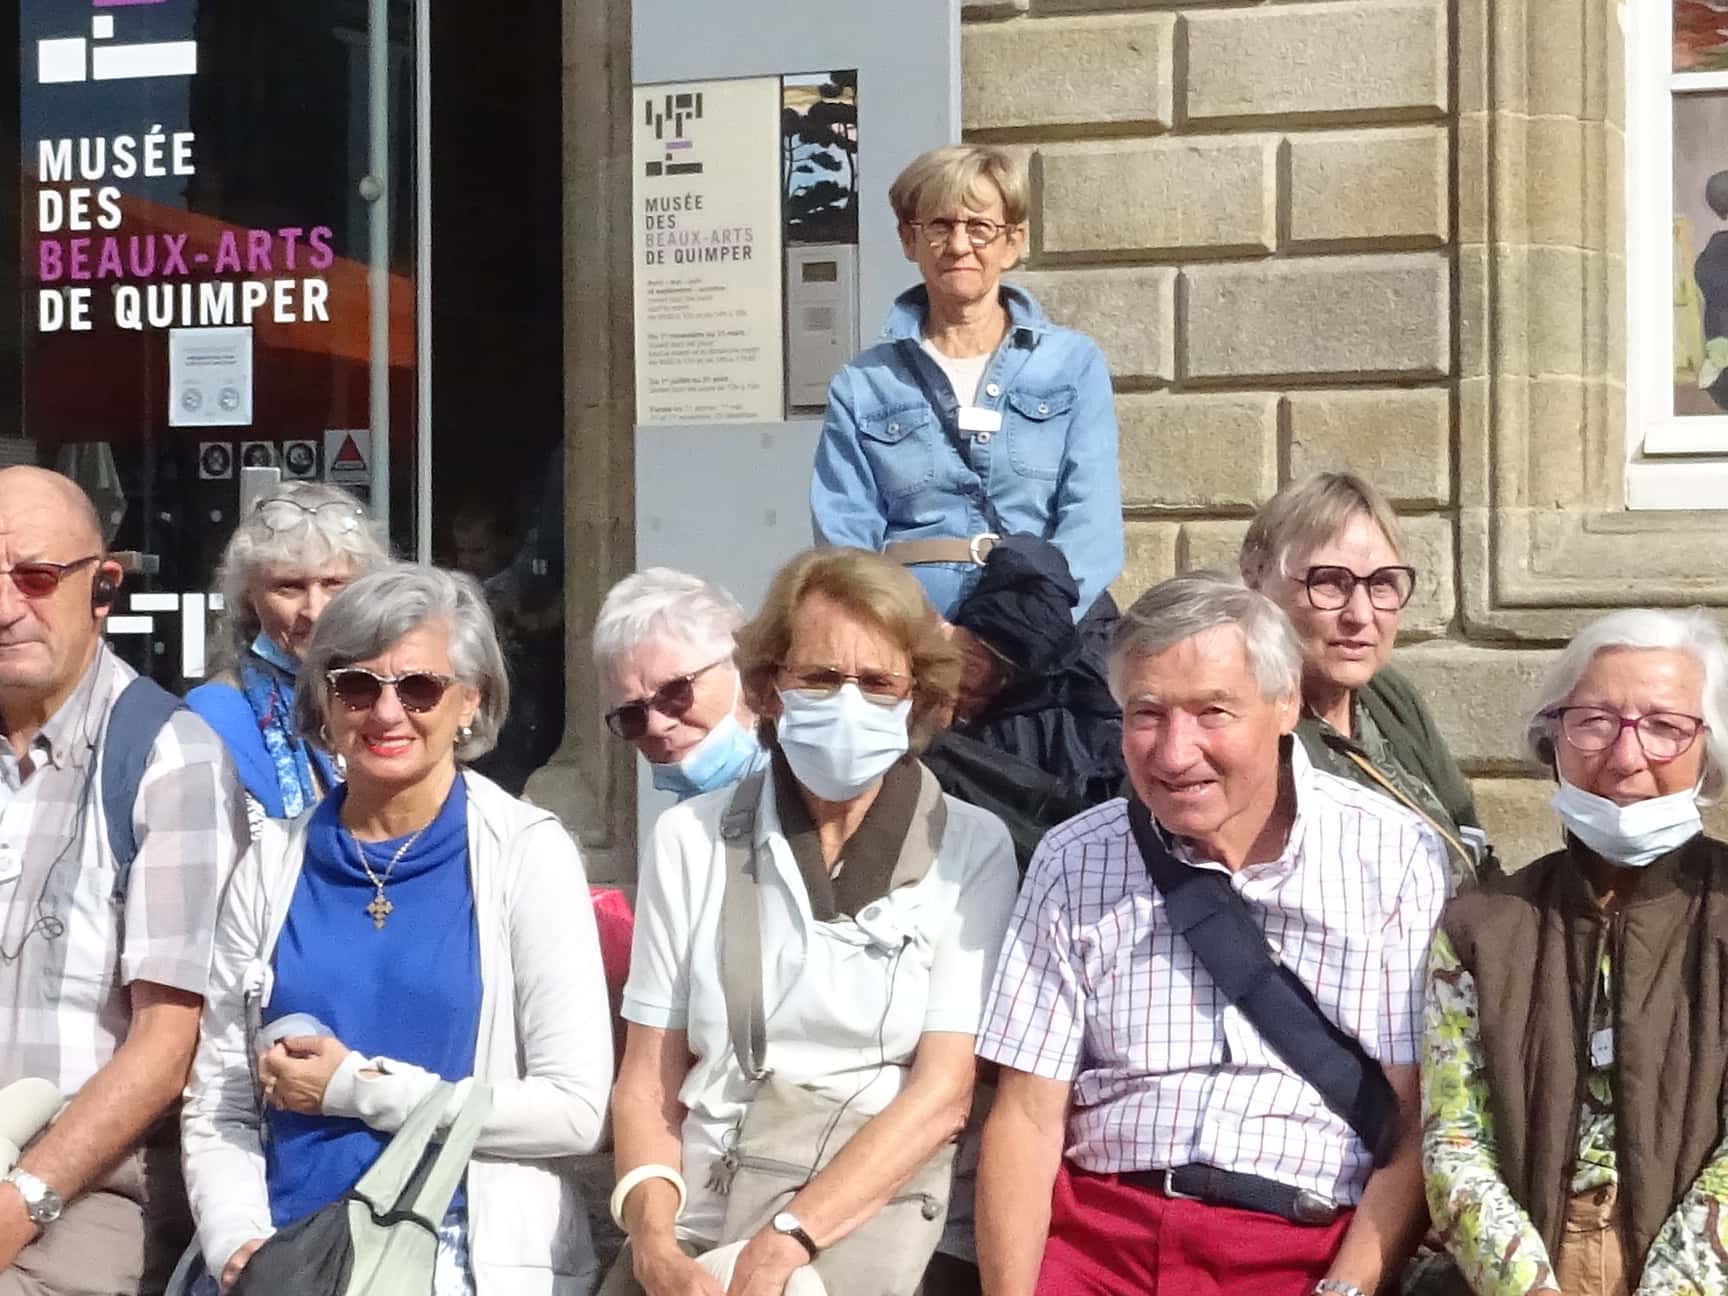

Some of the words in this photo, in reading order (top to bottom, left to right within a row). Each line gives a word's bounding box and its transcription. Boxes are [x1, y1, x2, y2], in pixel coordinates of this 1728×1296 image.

[39, 123, 196, 182] MUSÉE
[39, 186, 122, 232] DES
[645, 192, 704, 213] MUSÉE
[645, 214, 676, 230] DES
[645, 227, 753, 248] BEAUX-ARTS
[39, 226, 334, 282] BEAUX-ARTS
[646, 249, 665, 265] DE
[674, 245, 752, 264] QUIMPER
[39, 287, 93, 332] DE
[115, 278, 330, 331] QUIMPER
